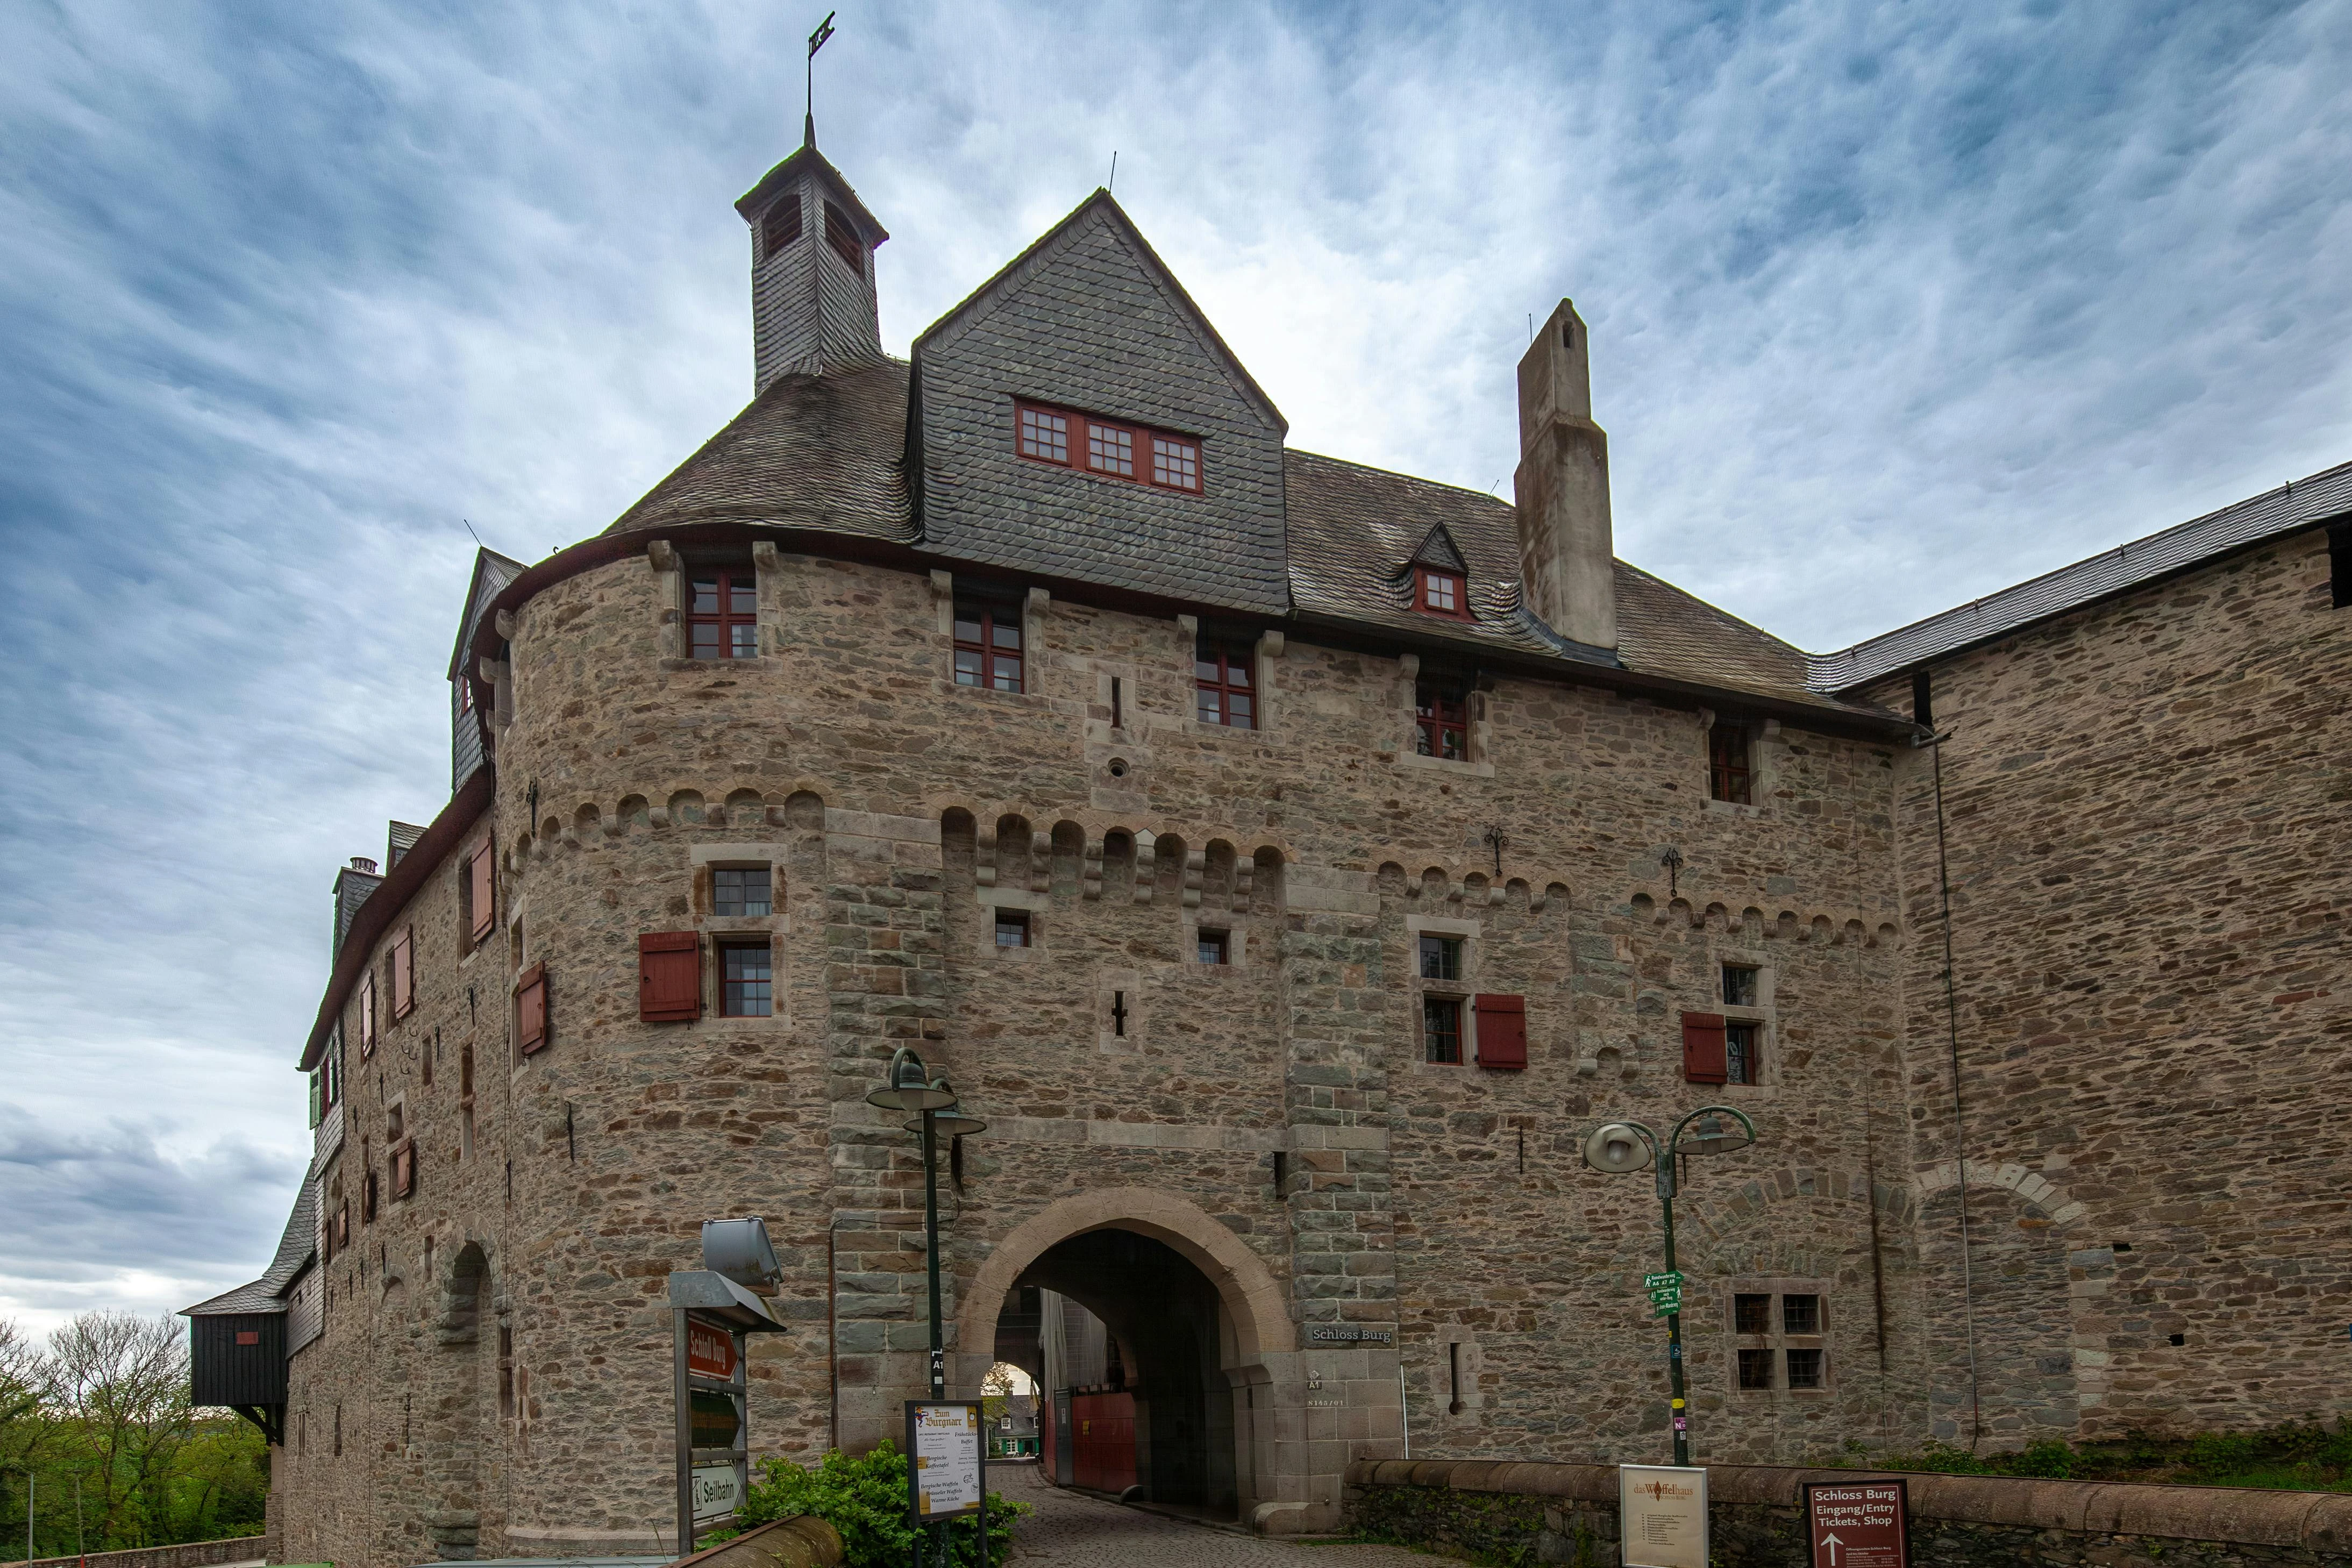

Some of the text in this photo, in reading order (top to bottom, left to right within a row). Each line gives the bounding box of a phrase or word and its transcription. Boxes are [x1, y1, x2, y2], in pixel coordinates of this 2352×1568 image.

[1313, 1329, 1391, 1343] Schloss Burg
[690, 1330, 725, 1371] Schloß Burg
[933, 1360, 943, 1369] A1
[935, 1409, 950, 1417] Zum
[925, 1417, 962, 1428] Burgnarr
[704, 1479, 734, 1503] Seilbahn
[1815, 1489, 1896, 1501] Schloss Burg
[1816, 1504, 1895, 1516] Eingang/Entry
[1818, 1516, 1892, 1527] Tickets, Shop
